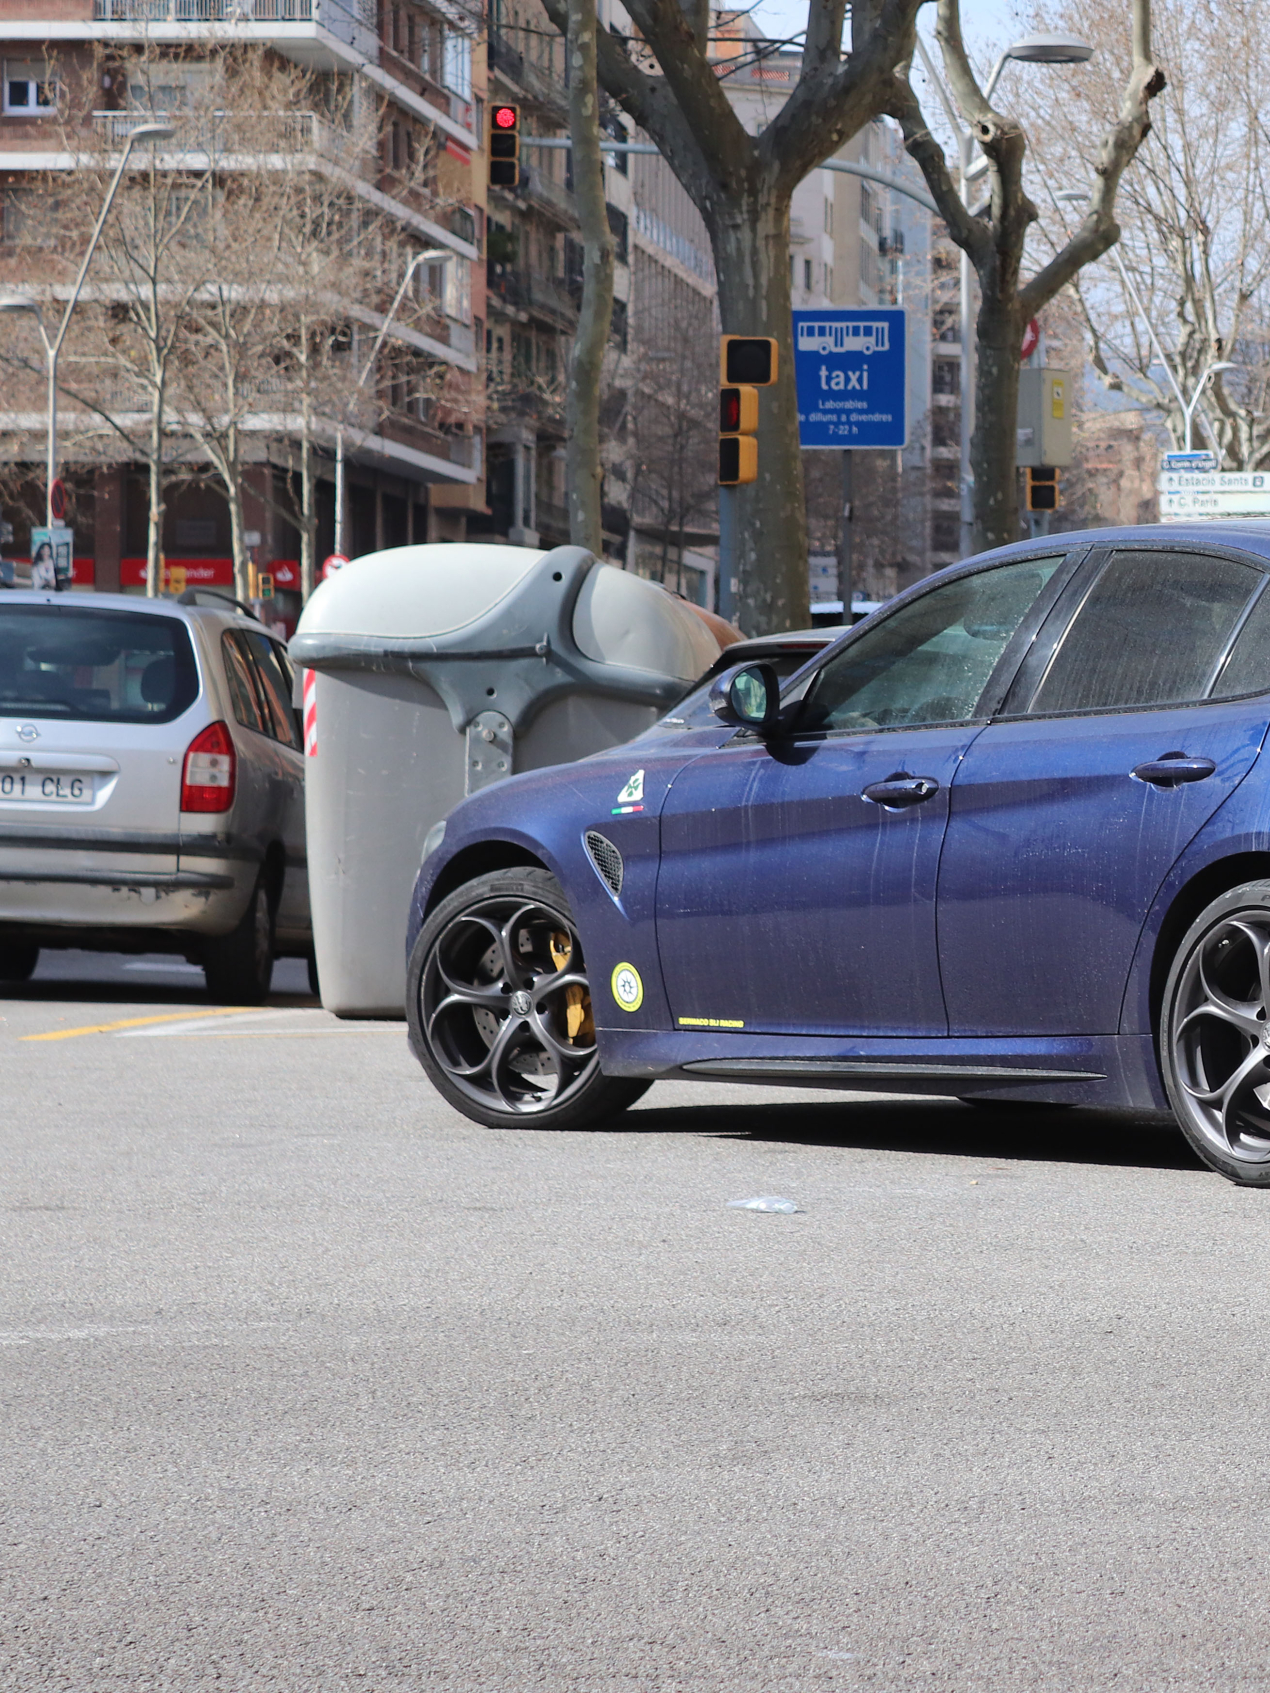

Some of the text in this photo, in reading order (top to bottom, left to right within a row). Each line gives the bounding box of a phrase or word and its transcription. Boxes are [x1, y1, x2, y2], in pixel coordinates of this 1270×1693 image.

[819, 364, 869, 390] taxi
[818, 400, 868, 409] Laborables
[809, 413, 838, 422] dilluns
[841, 414, 847, 422] a
[850, 413, 892, 422] divendres
[828, 425, 858, 434] 7-22 h
[41, 776, 84, 798] CLG
